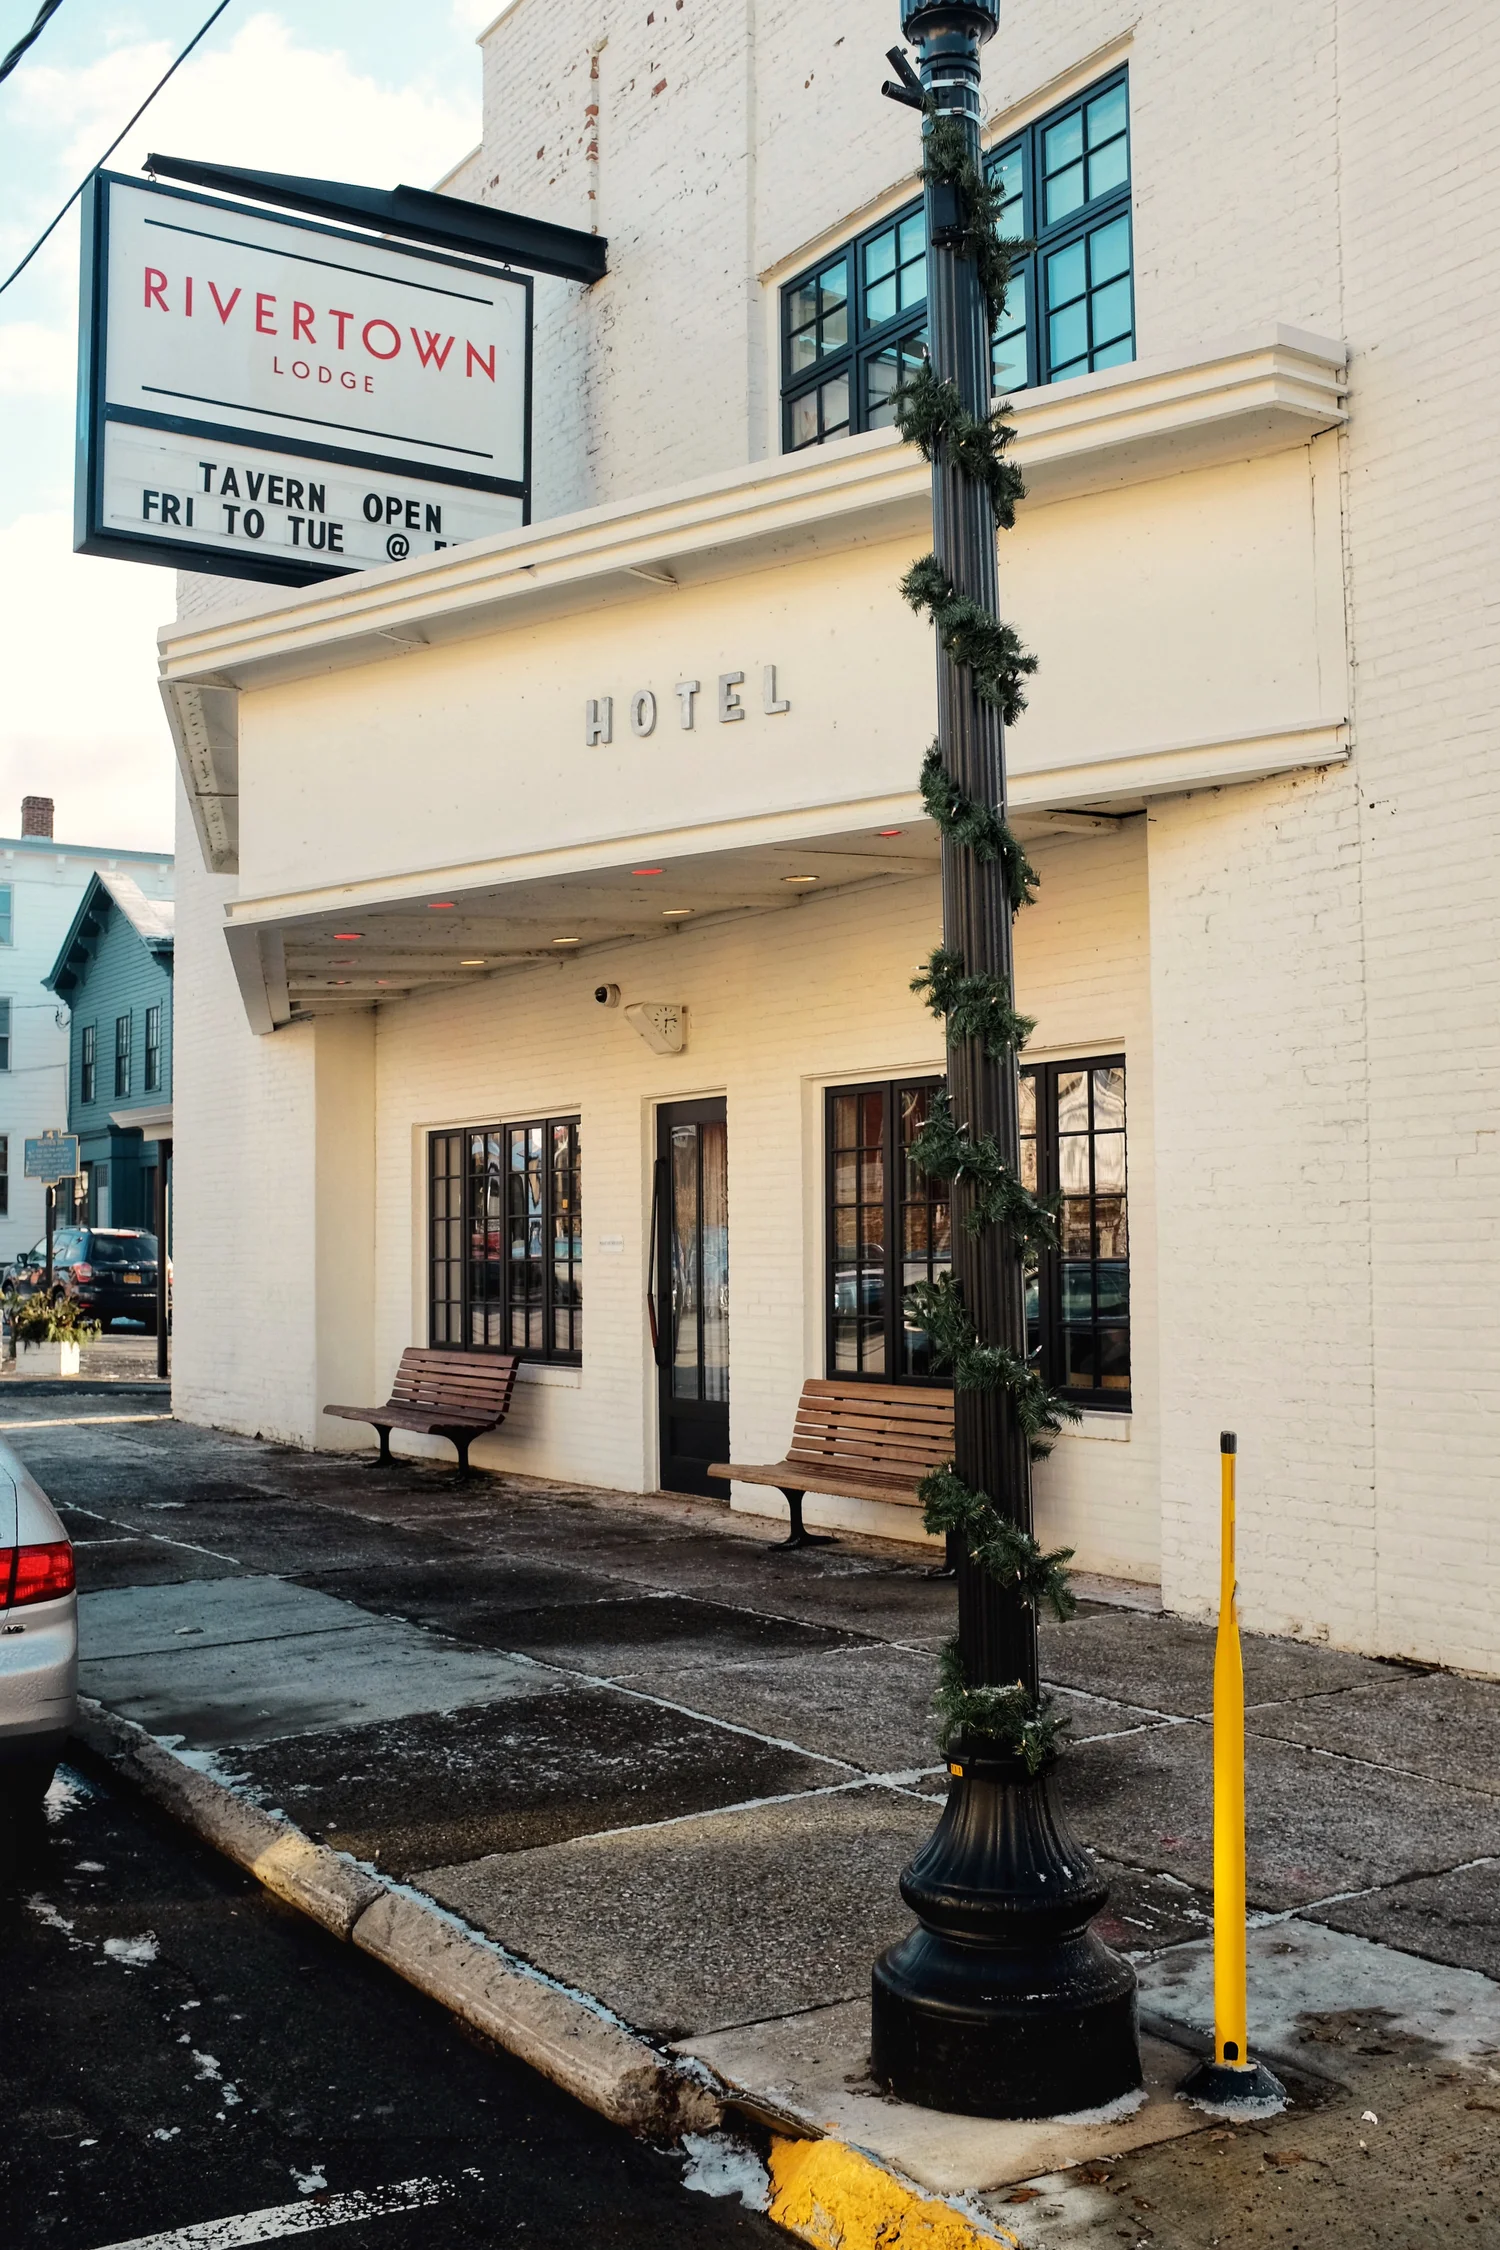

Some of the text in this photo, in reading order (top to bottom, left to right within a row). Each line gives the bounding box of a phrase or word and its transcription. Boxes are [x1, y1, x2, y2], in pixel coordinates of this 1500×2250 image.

[144, 267, 495, 382] RIVERTOWN
[273, 356, 374, 393] LODGE
[143, 489, 410, 561] FRI TO TUE @
[199, 461, 442, 533] TAVERN OPEN
[586, 664, 790, 746] HOTEL
